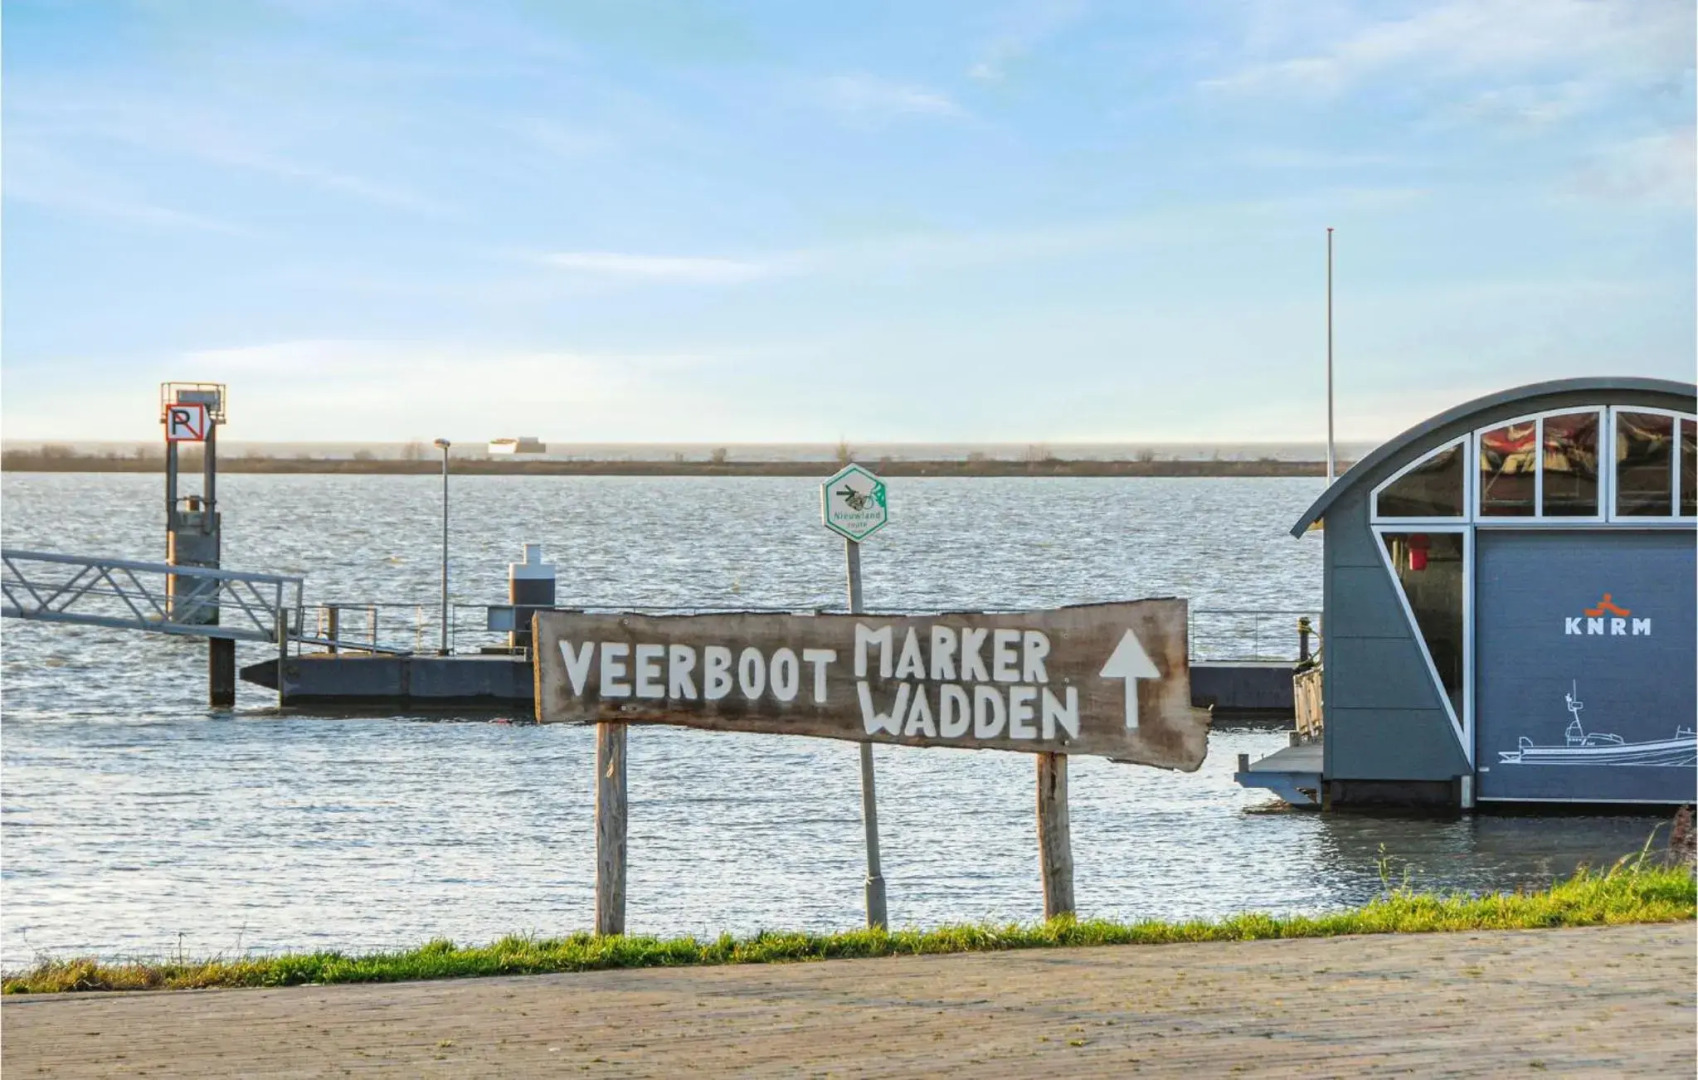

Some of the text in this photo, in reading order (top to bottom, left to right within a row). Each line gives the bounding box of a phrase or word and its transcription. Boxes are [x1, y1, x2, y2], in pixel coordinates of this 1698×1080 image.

[171, 409, 190, 435] P
[854, 623, 1050, 683] MARKER
[1565, 617, 1651, 635] KNRM
[558, 639, 837, 702] VEERBOOT
[855, 680, 1080, 740] WADDEN
